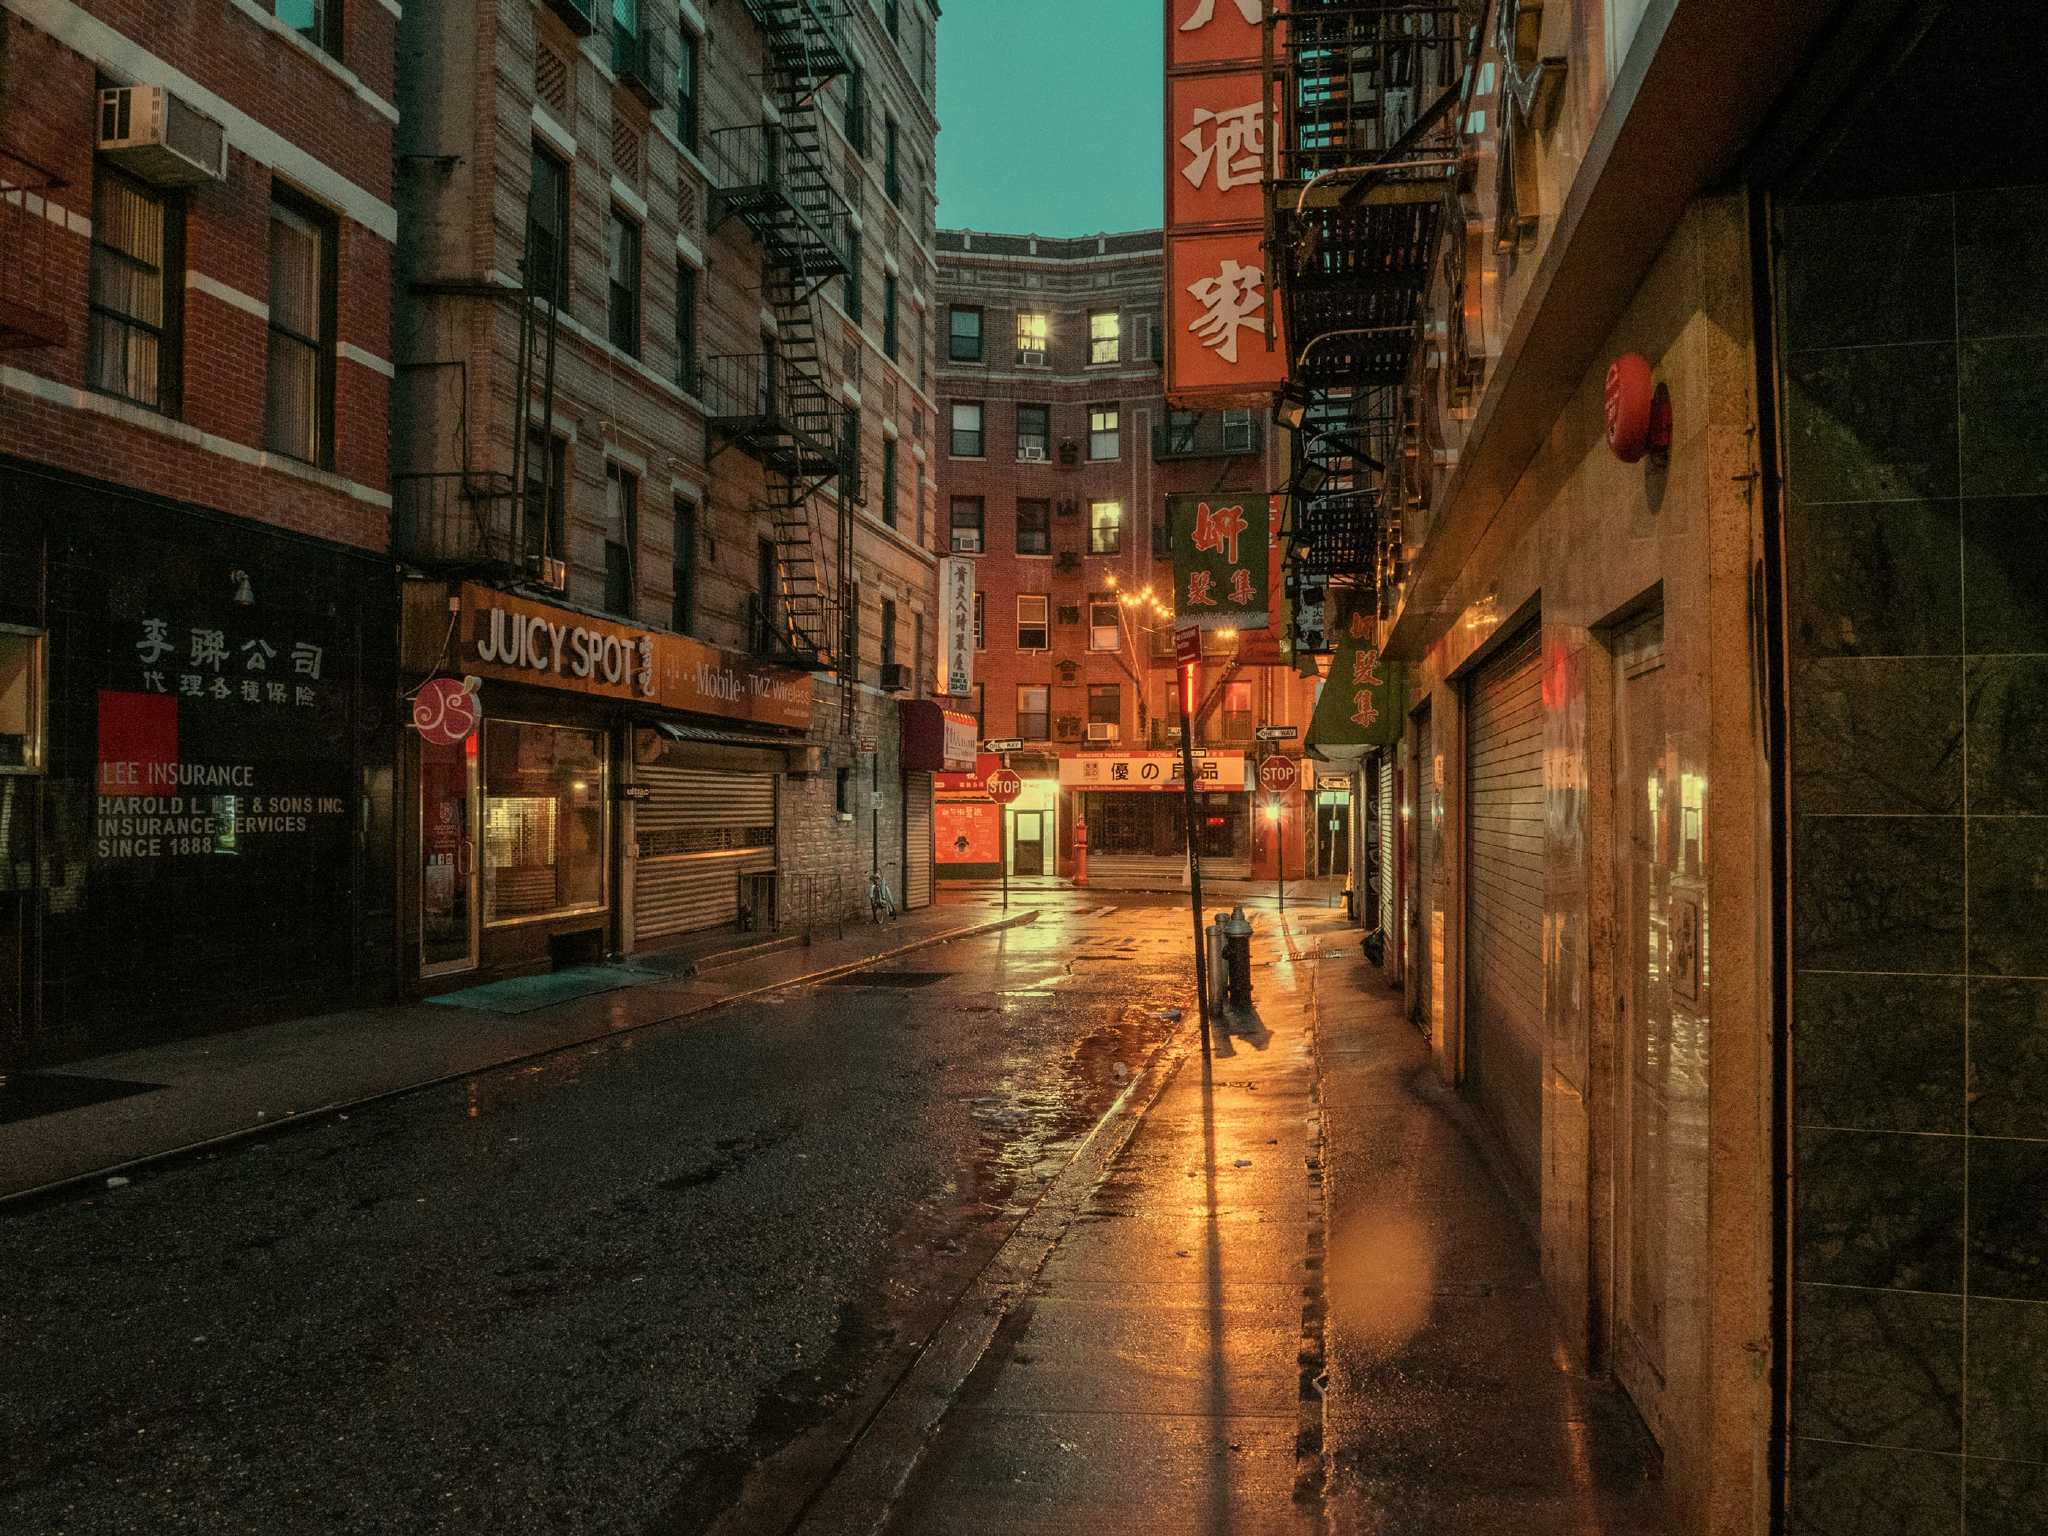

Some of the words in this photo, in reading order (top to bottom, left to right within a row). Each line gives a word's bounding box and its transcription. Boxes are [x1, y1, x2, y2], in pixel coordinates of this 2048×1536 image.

[478, 607, 566, 673] JUICY
[571, 626, 636, 685] SPOT
[748, 674, 771, 698] TMZ
[772, 679, 811, 705] Wireless
[103, 761, 140, 785] LEE
[148, 762, 254, 787] INSURANCE
[1262, 767, 1294, 780] STOP
[989, 780, 1020, 793] STOP
[98, 797, 184, 815] HAROLD
[252, 797, 263, 815] &
[269, 797, 313, 814] SONS
[98, 817, 217, 837] INSURANCE
[98, 838, 161, 858] SINCE
[170, 837, 213, 855] 1888
